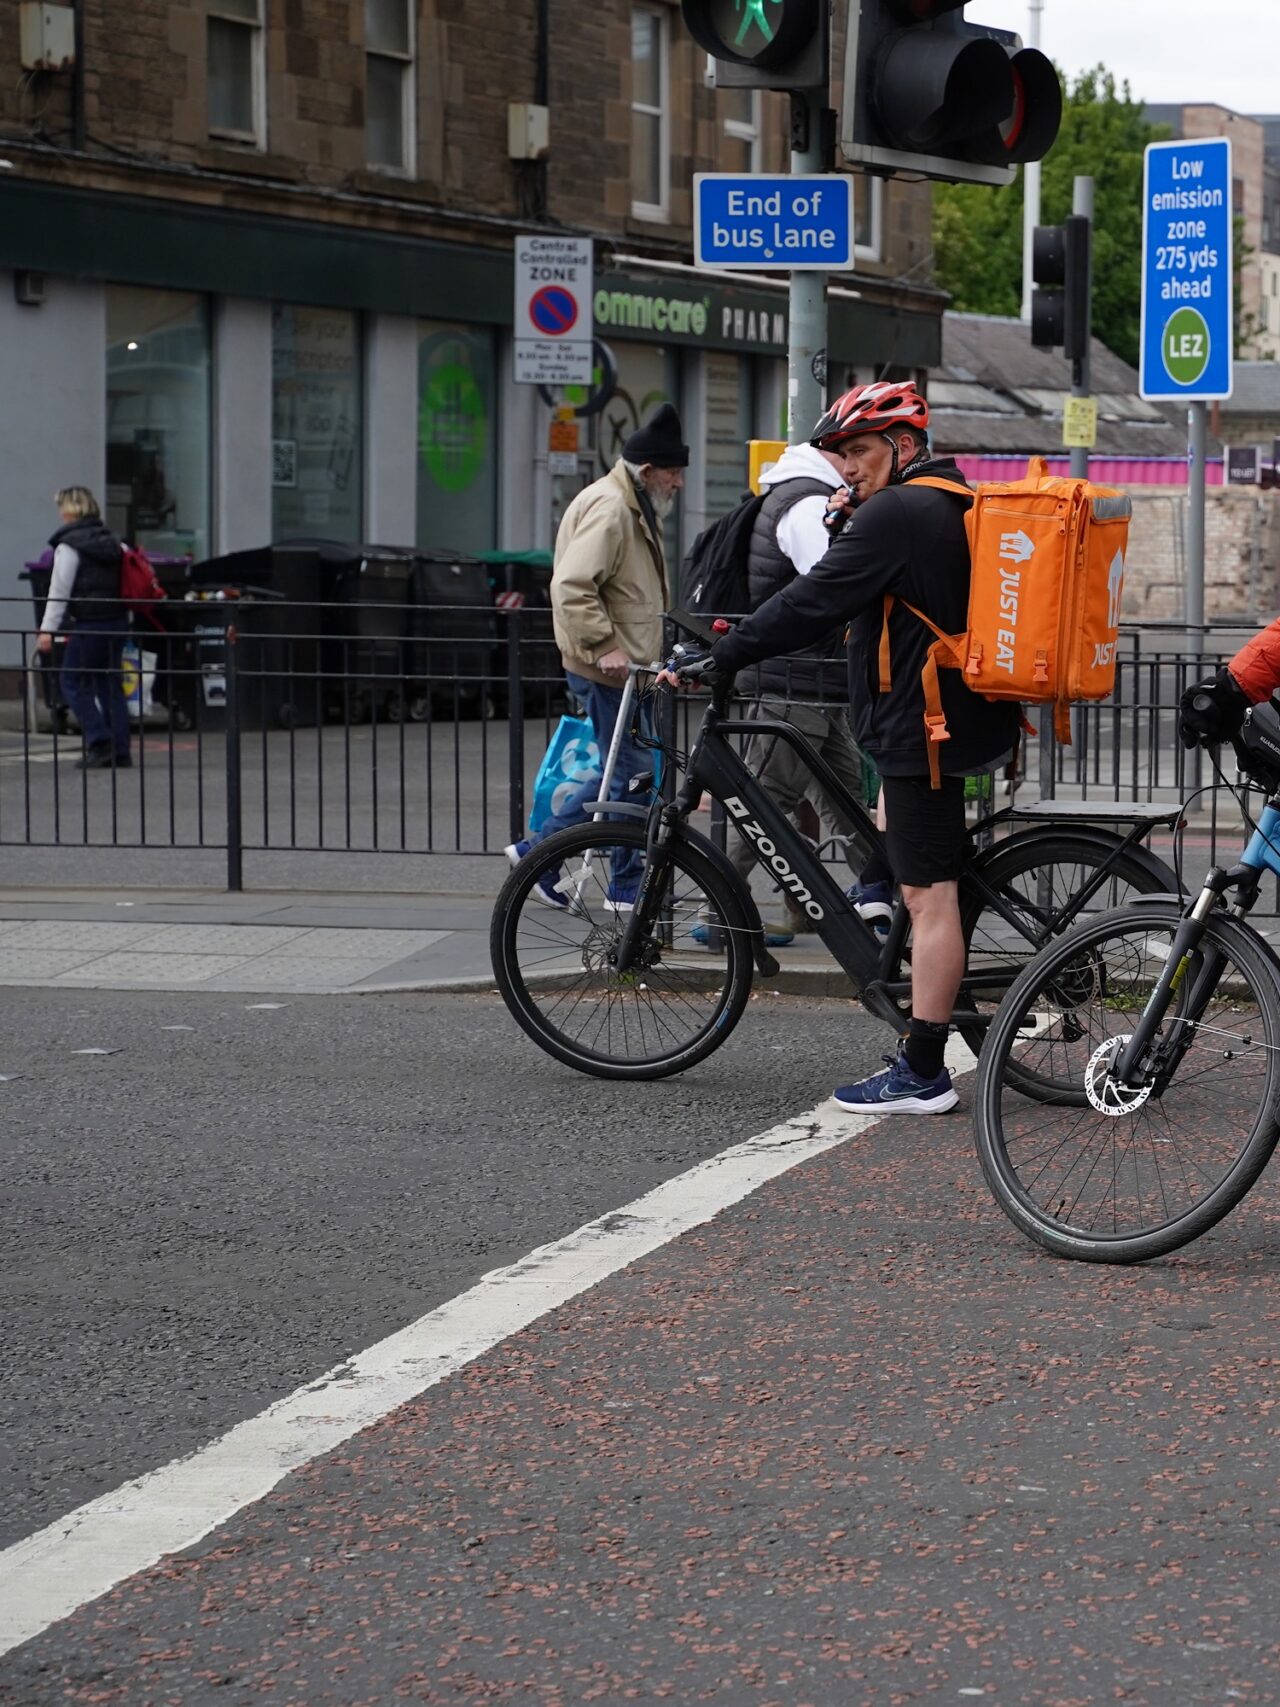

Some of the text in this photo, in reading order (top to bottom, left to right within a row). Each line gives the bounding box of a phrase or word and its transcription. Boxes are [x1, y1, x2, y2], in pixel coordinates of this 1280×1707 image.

[1171, 157, 1204, 180] Low
[727, 190, 823, 217] End of
[1151, 185, 1223, 211] emission
[712, 222, 836, 248] bus lane
[1167, 219, 1206, 240] zone
[529, 239, 578, 251] Central
[519, 252, 588, 265] Controlled
[1155, 244, 1218, 273] 275 yds
[529, 267, 577, 281] ZONE
[1160, 274, 1212, 300] ahead
[593, 288, 789, 346] omnicare PHARM
[1169, 334, 1204, 358] LEZ
[995, 567, 1021, 675] JUST EAT
[742, 820, 824, 921] zoomo
